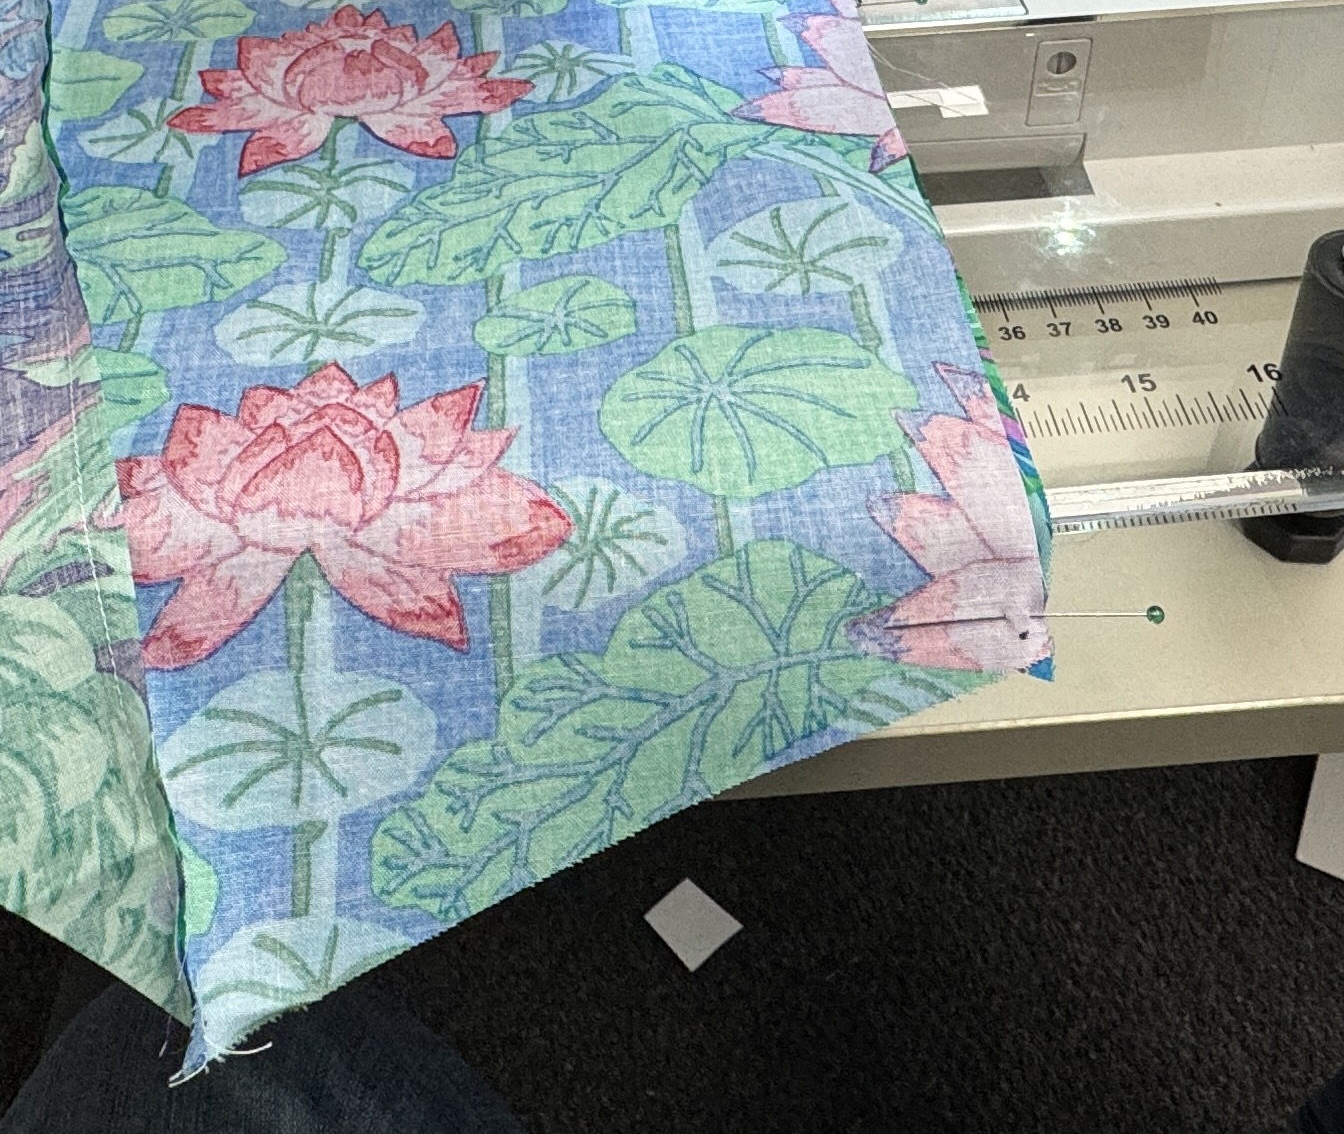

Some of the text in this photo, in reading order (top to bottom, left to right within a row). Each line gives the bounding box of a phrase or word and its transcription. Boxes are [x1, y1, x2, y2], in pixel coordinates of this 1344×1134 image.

[997, 310, 1219, 342] 36 37 38 39 40
[1120, 372, 1158, 394] 15
[1246, 362, 1284, 383] 16
